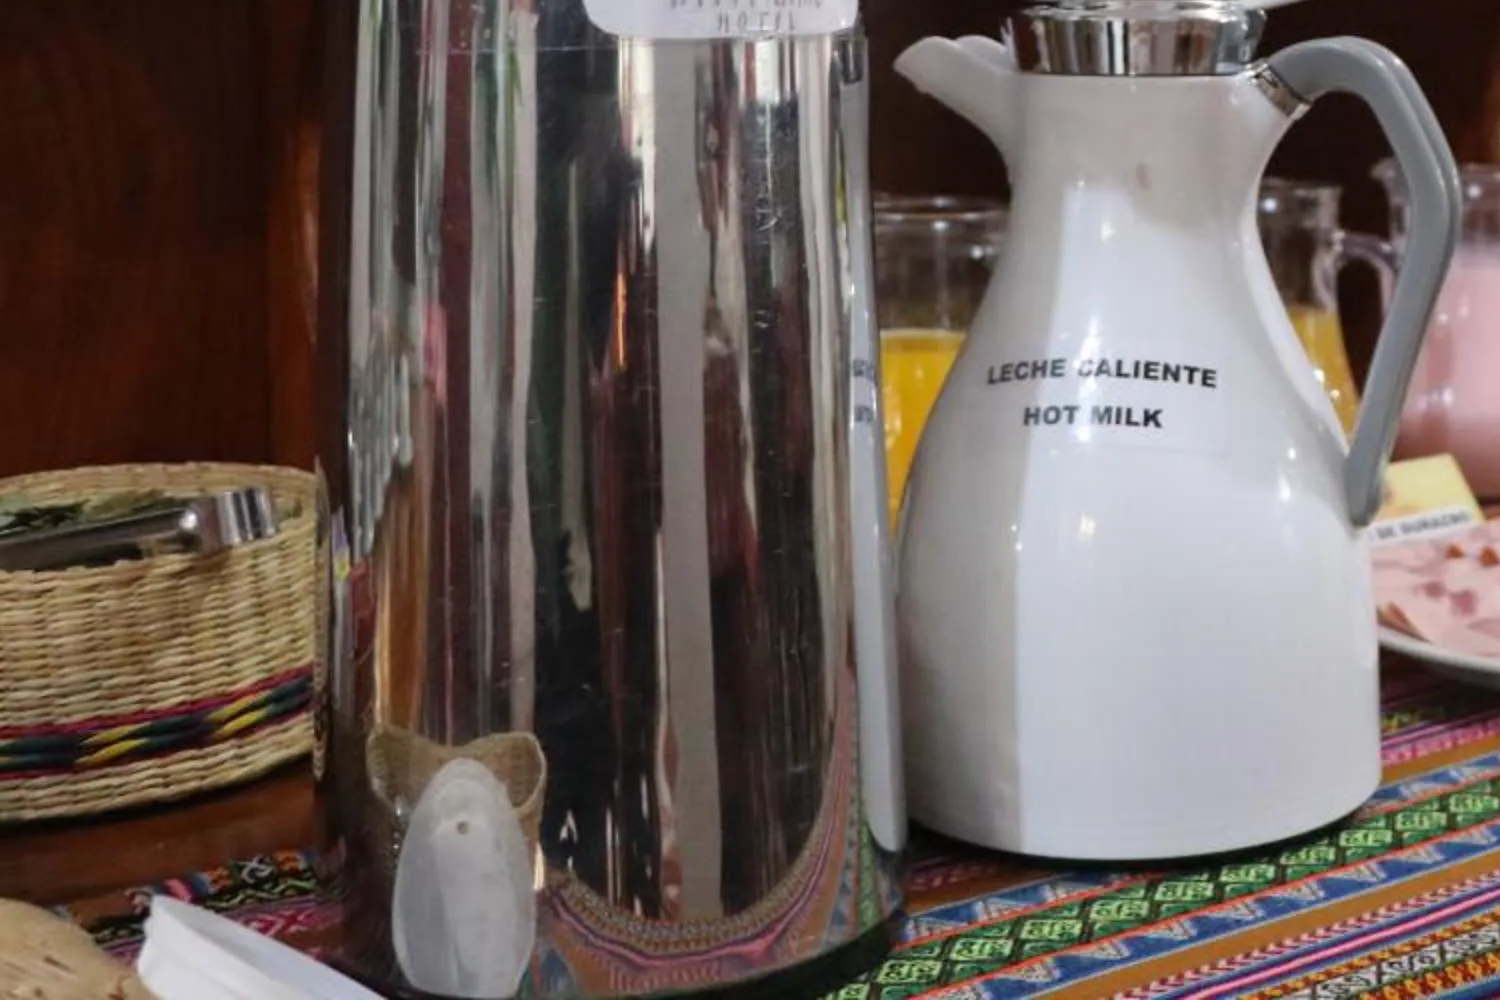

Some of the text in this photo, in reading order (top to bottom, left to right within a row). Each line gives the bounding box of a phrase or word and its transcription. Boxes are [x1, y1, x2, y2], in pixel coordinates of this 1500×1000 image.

[987, 358, 1217, 389] LECHE CALIENTE
[1023, 404, 1164, 429] HOT MILK
